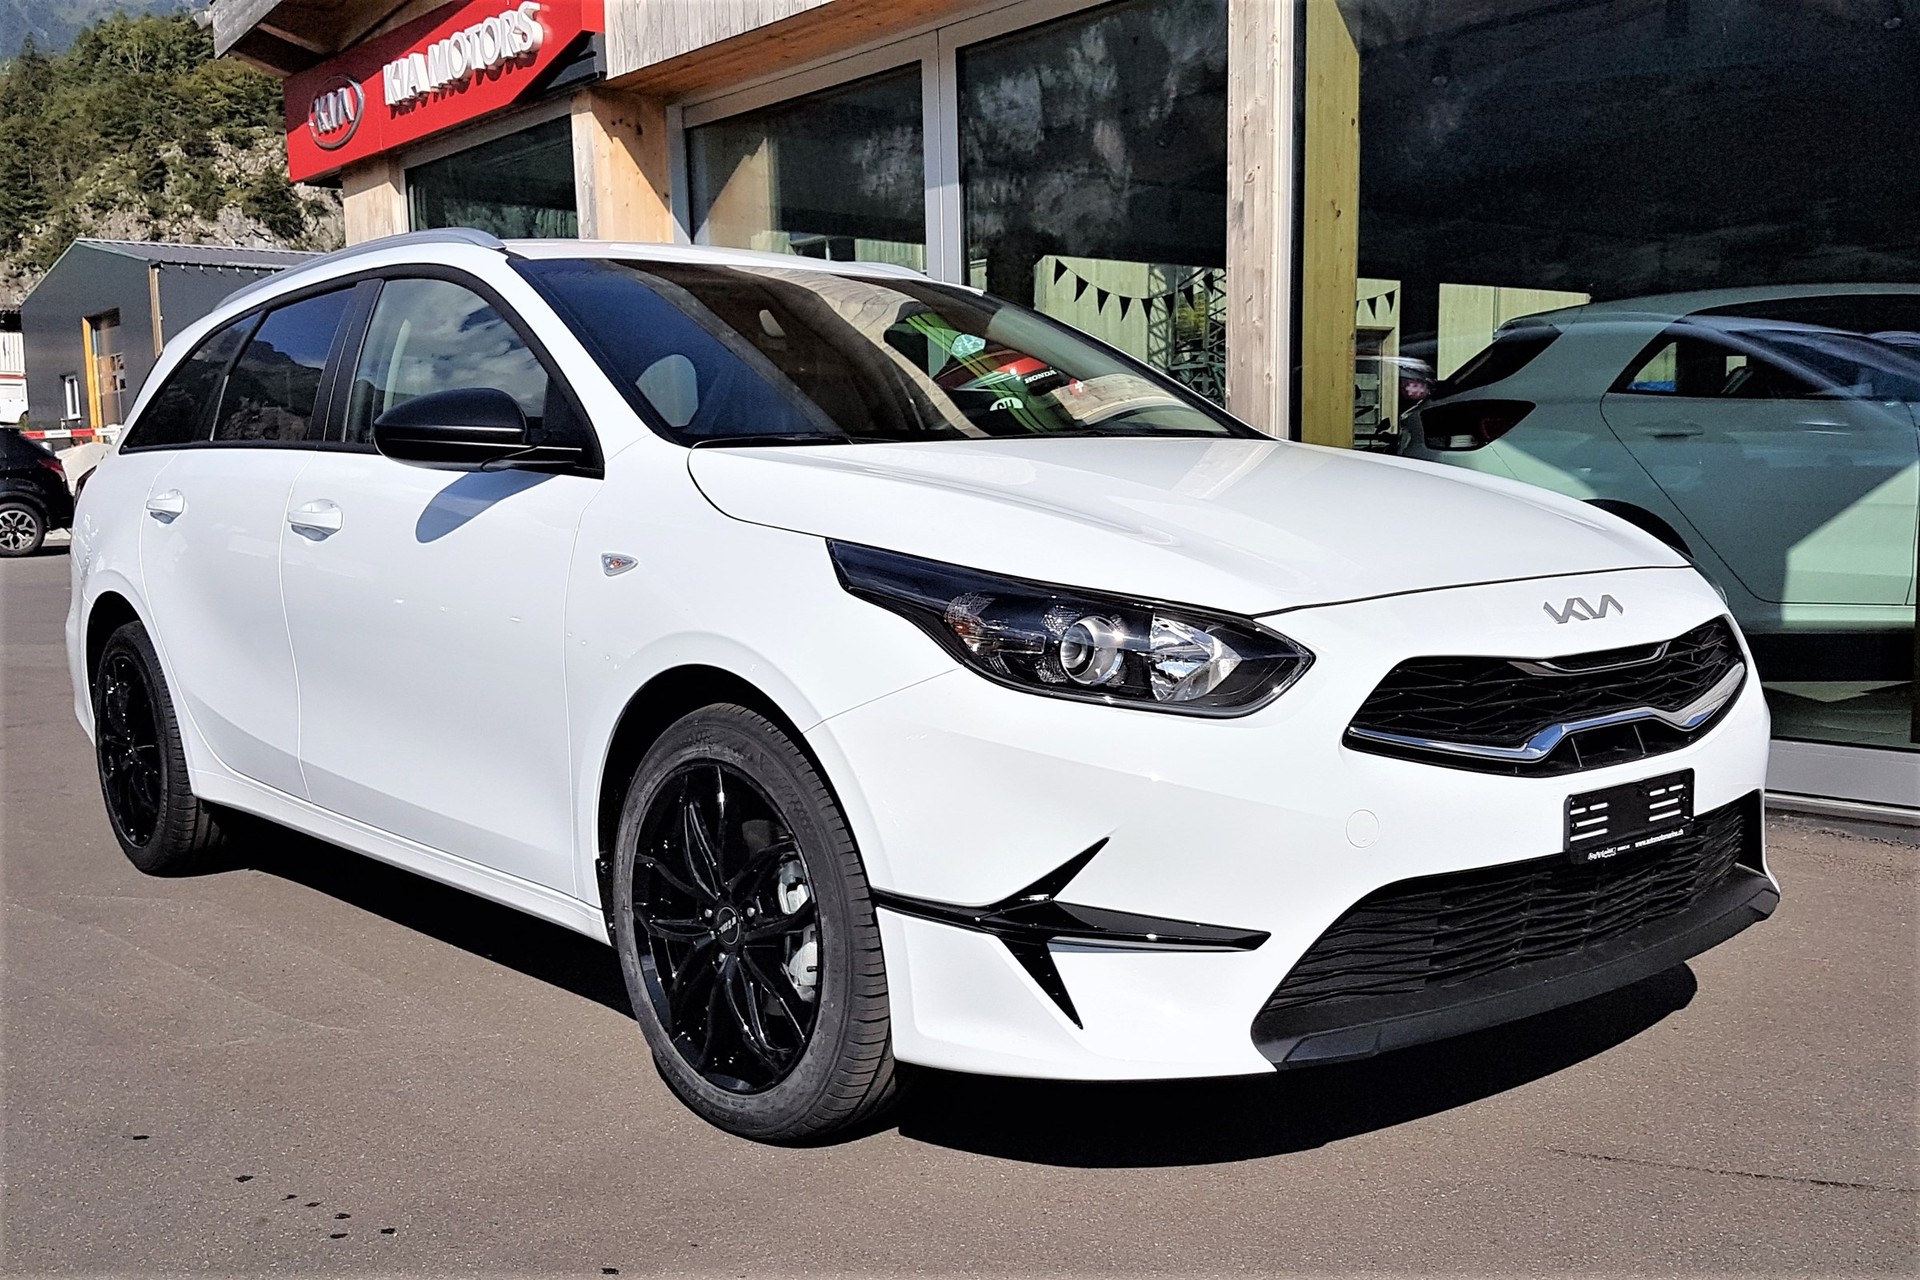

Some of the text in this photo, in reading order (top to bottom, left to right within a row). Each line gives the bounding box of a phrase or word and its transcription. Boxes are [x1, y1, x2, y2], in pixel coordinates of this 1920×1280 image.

[383, 1, 544, 105] KIA MOTORS
[314, 87, 355, 134] KIA
[1024, 369, 1057, 384] HONDA
[1543, 594, 1624, 624] KIA
